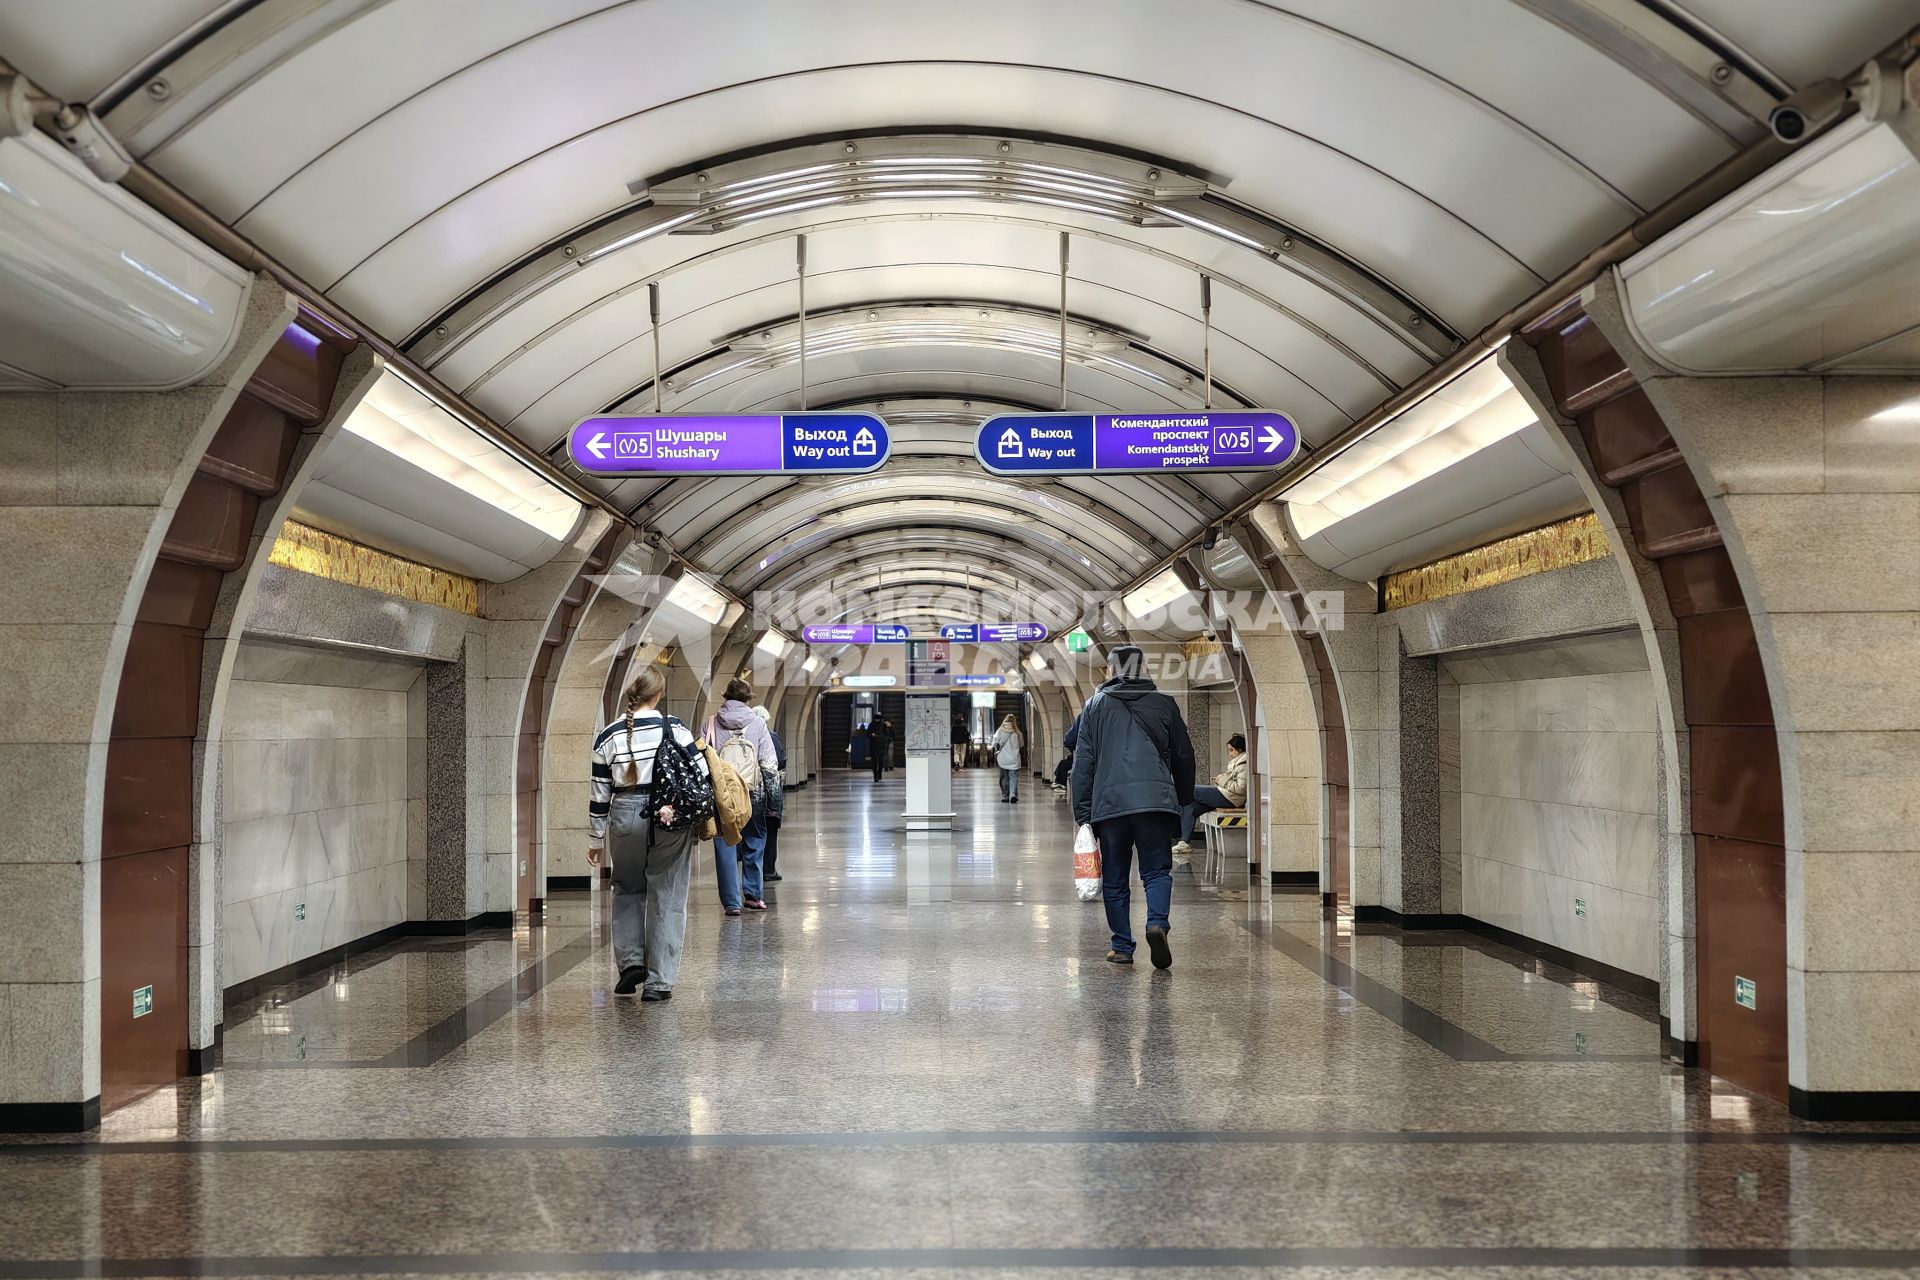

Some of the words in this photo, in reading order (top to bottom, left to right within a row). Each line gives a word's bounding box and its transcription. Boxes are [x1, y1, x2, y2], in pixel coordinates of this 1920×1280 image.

[1111, 417, 1209, 429] Комендантский
[655, 430, 727, 442] Шушары
[794, 428, 847, 442] Выход
[1030, 428, 1073, 440] Выход
[1152, 430, 1210, 441] проспект
[656, 446, 720, 460] Shushary
[793, 446, 826, 459] Way
[827, 446, 850, 457] out
[1028, 448, 1053, 459] Way
[1056, 448, 1076, 458] out
[1127, 444, 1210, 456] Komendantskiy
[1162, 455, 1210, 466] prospekt
